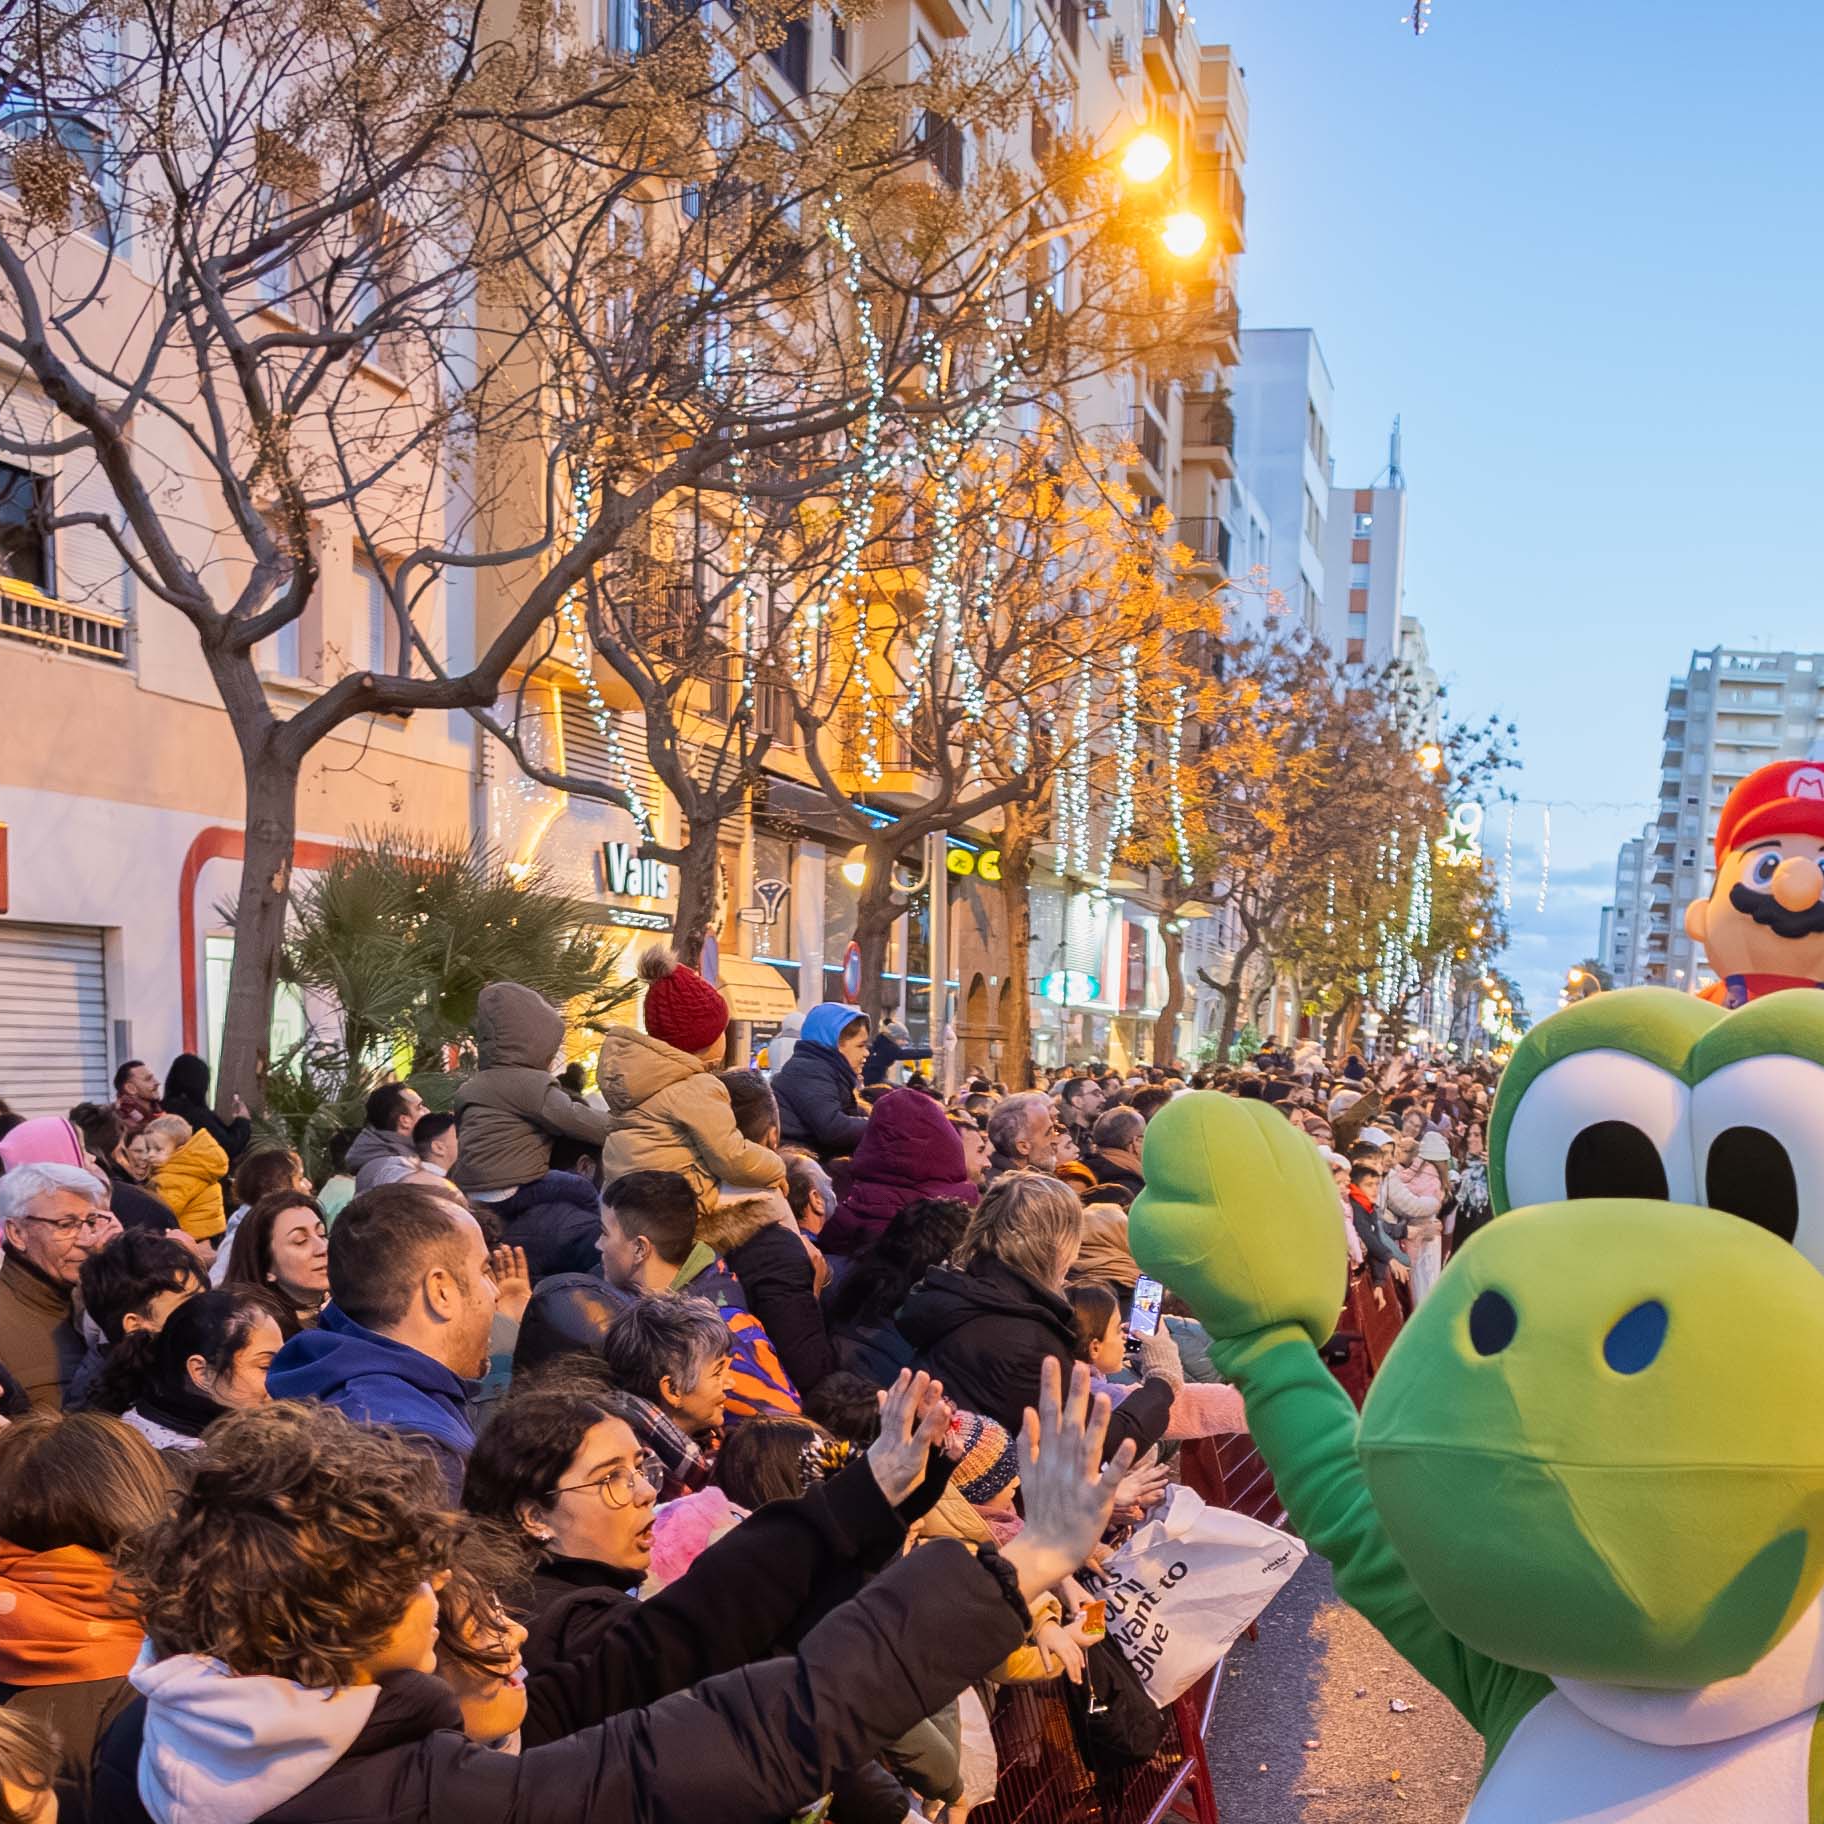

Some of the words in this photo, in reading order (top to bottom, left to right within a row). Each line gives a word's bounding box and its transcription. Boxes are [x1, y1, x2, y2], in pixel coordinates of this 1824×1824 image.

[1104, 1578, 1146, 1622] ou'll
[1112, 1591, 1162, 1646] want
[1158, 1561, 1188, 1589] to
[1129, 1622, 1169, 1683] give
